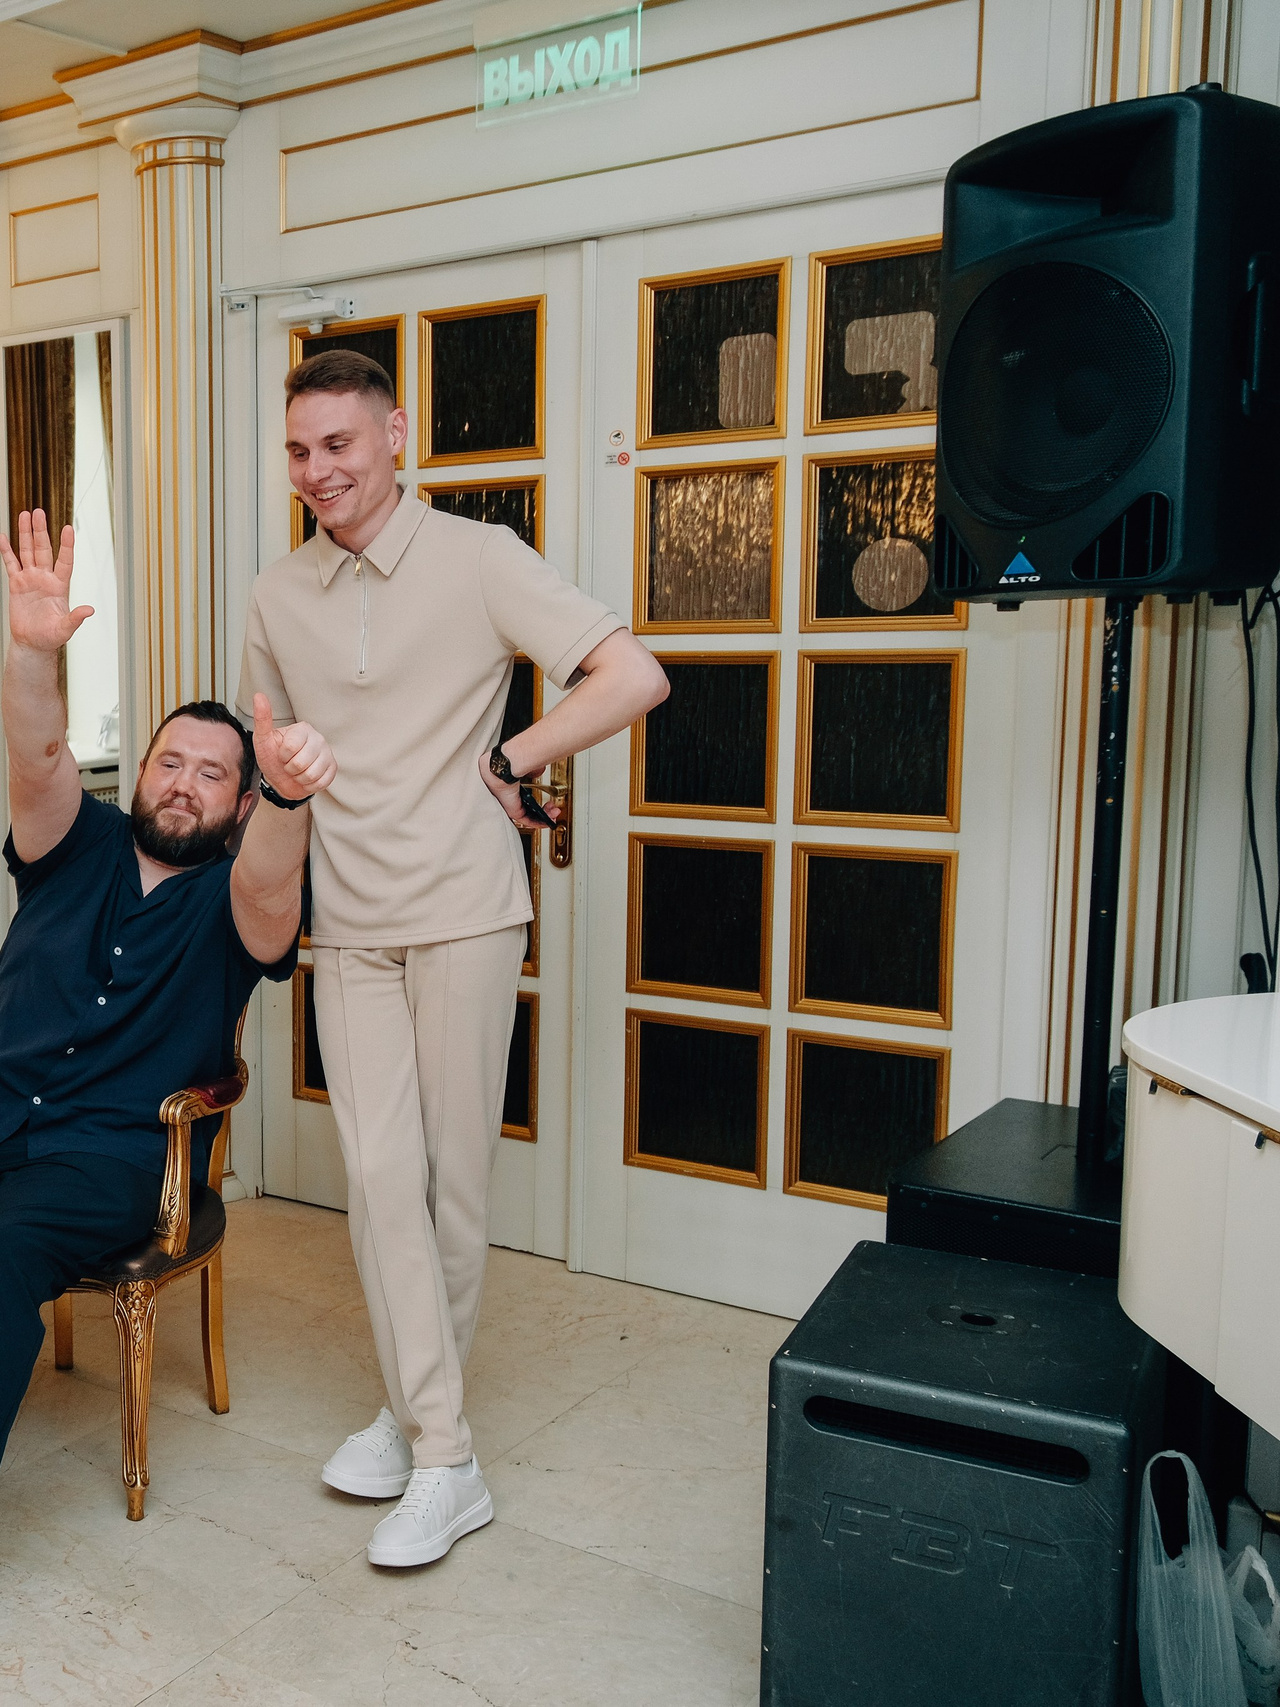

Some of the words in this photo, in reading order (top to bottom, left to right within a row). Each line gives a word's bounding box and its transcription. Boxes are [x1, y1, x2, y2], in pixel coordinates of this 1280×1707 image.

[484, 26, 632, 111] ВЫХОД
[998, 575, 1041, 584] ALTO
[821, 1491, 1060, 1589] FBT
